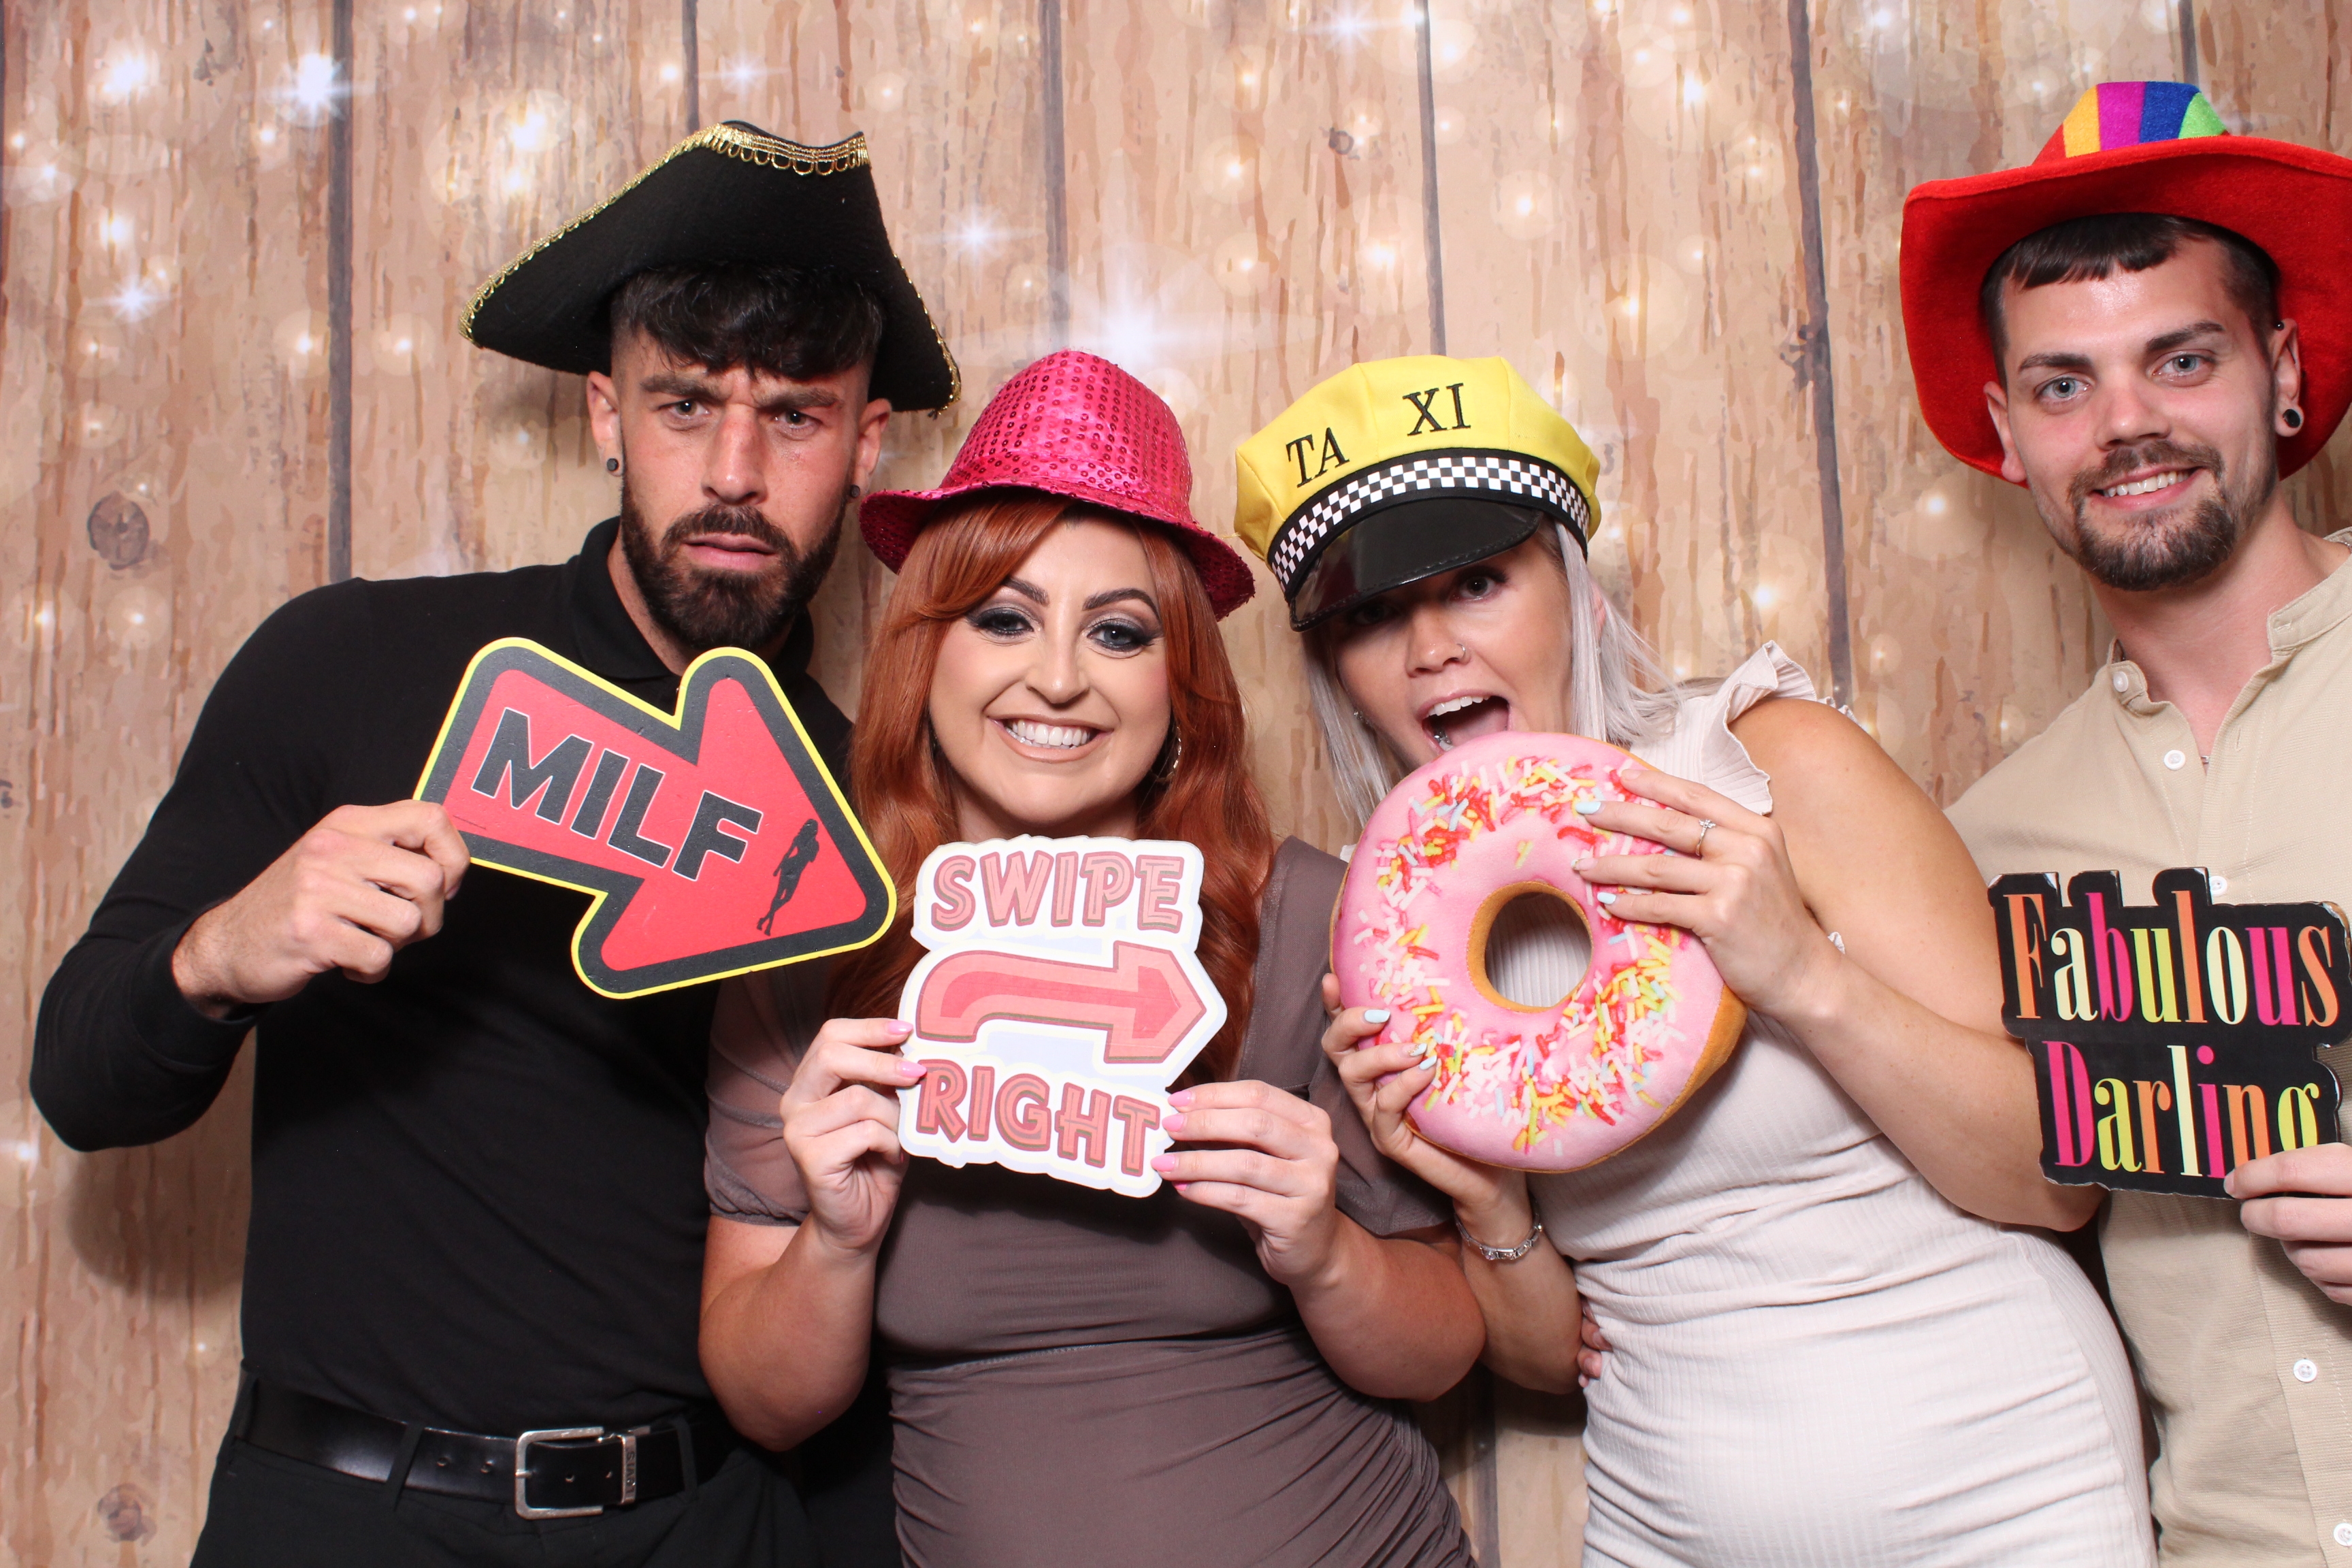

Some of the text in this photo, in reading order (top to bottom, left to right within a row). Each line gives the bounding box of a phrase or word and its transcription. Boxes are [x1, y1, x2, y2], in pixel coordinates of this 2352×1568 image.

[470, 706, 764, 882] MILF
[930, 849, 1185, 934] SWIPE
[2002, 889, 2340, 1028] Fabulous
[915, 1059, 1161, 1177] RIGHT
